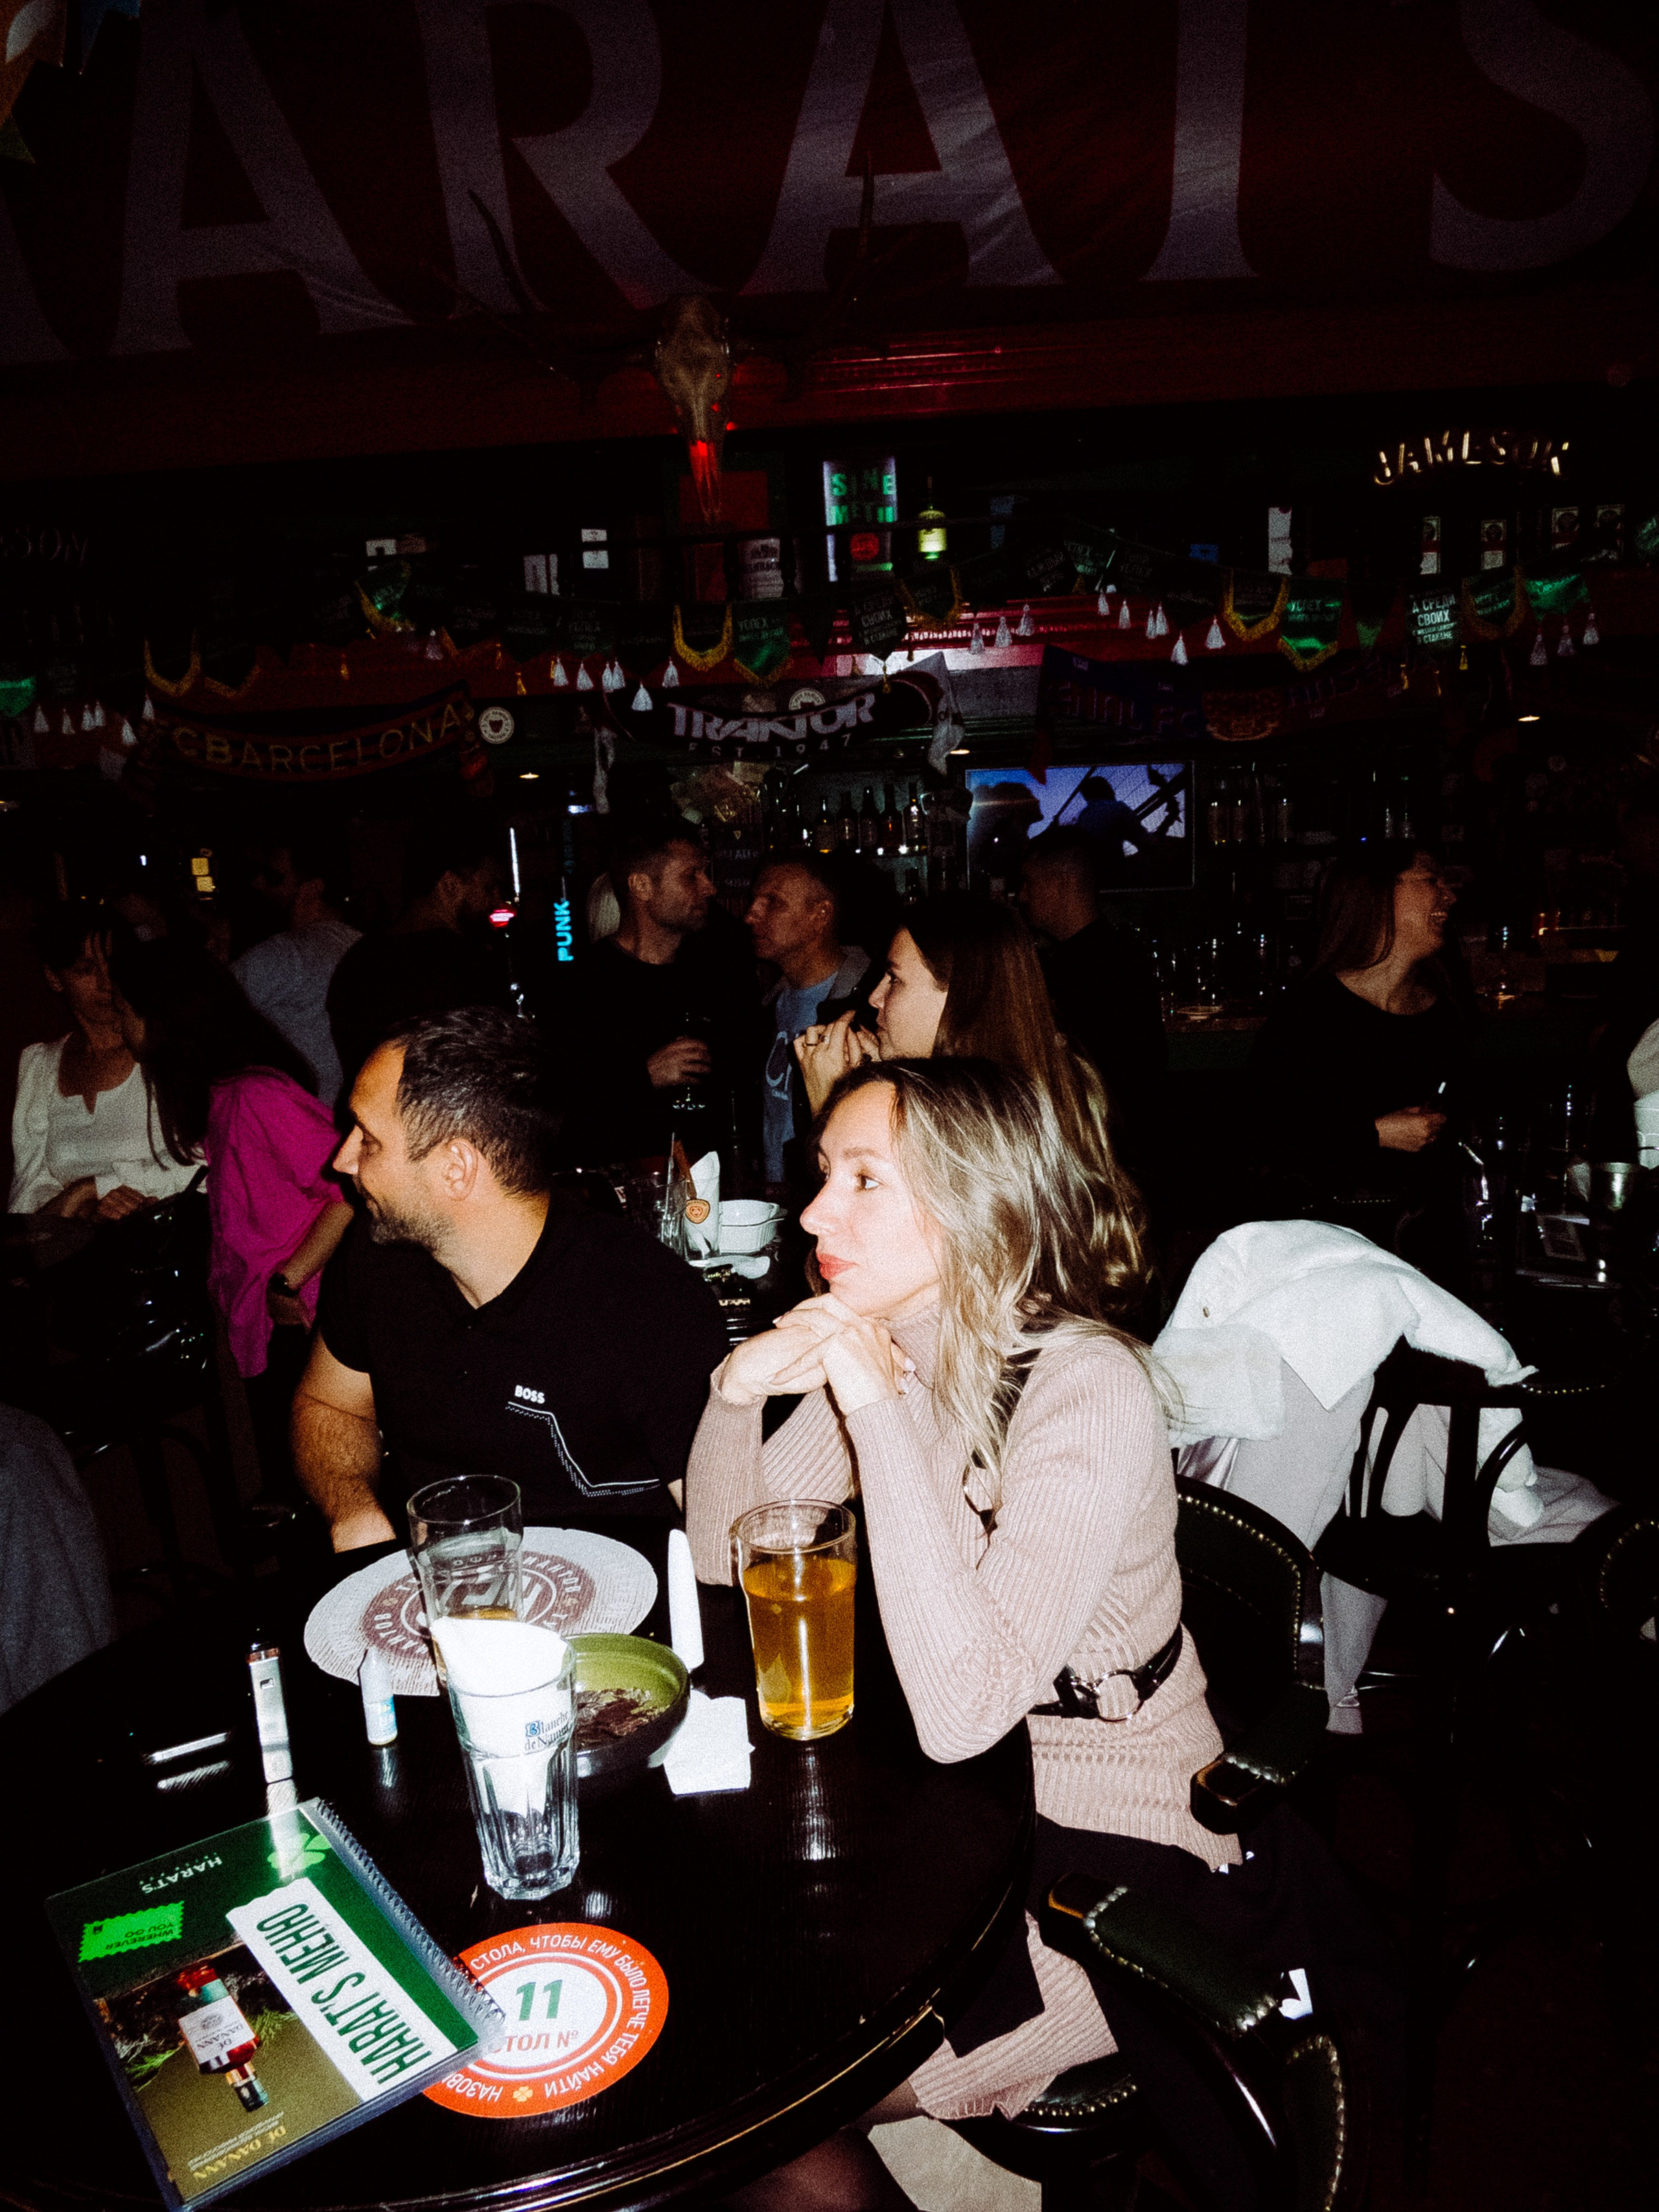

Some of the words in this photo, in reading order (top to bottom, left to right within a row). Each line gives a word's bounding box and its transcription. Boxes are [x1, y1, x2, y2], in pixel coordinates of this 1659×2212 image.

[1422, 593, 1456, 611] СРЕДИ
[1417, 609, 1451, 627] СВОИХ
[552, 899, 575, 962] PUNK
[514, 1384, 546, 1405] BOSS
[524, 1739, 536, 1751] de
[141, 1856, 224, 1894] HARAT'S
[106, 1928, 174, 1950] WHEREVER
[124, 1928, 145, 1938] GO
[147, 1922, 174, 1934] YOU
[530, 1935, 588, 1949] ЧТОБЫ
[470, 1942, 526, 1970] СТОЛА,
[588, 1940, 621, 1959] ЕМУ
[614, 1955, 647, 1988] БЫЛО
[515, 1979, 563, 2022] 11
[627, 1989, 651, 2031] ЛЕГЧЕ
[311, 1969, 433, 2086] HARAT'S
[601, 2030, 640, 2067] ТЕБЯ
[441, 2072, 504, 2102] НАЗОВ
[543, 2062, 605, 2098] НАЙТИ
[192, 2139, 261, 2180] DANANN
